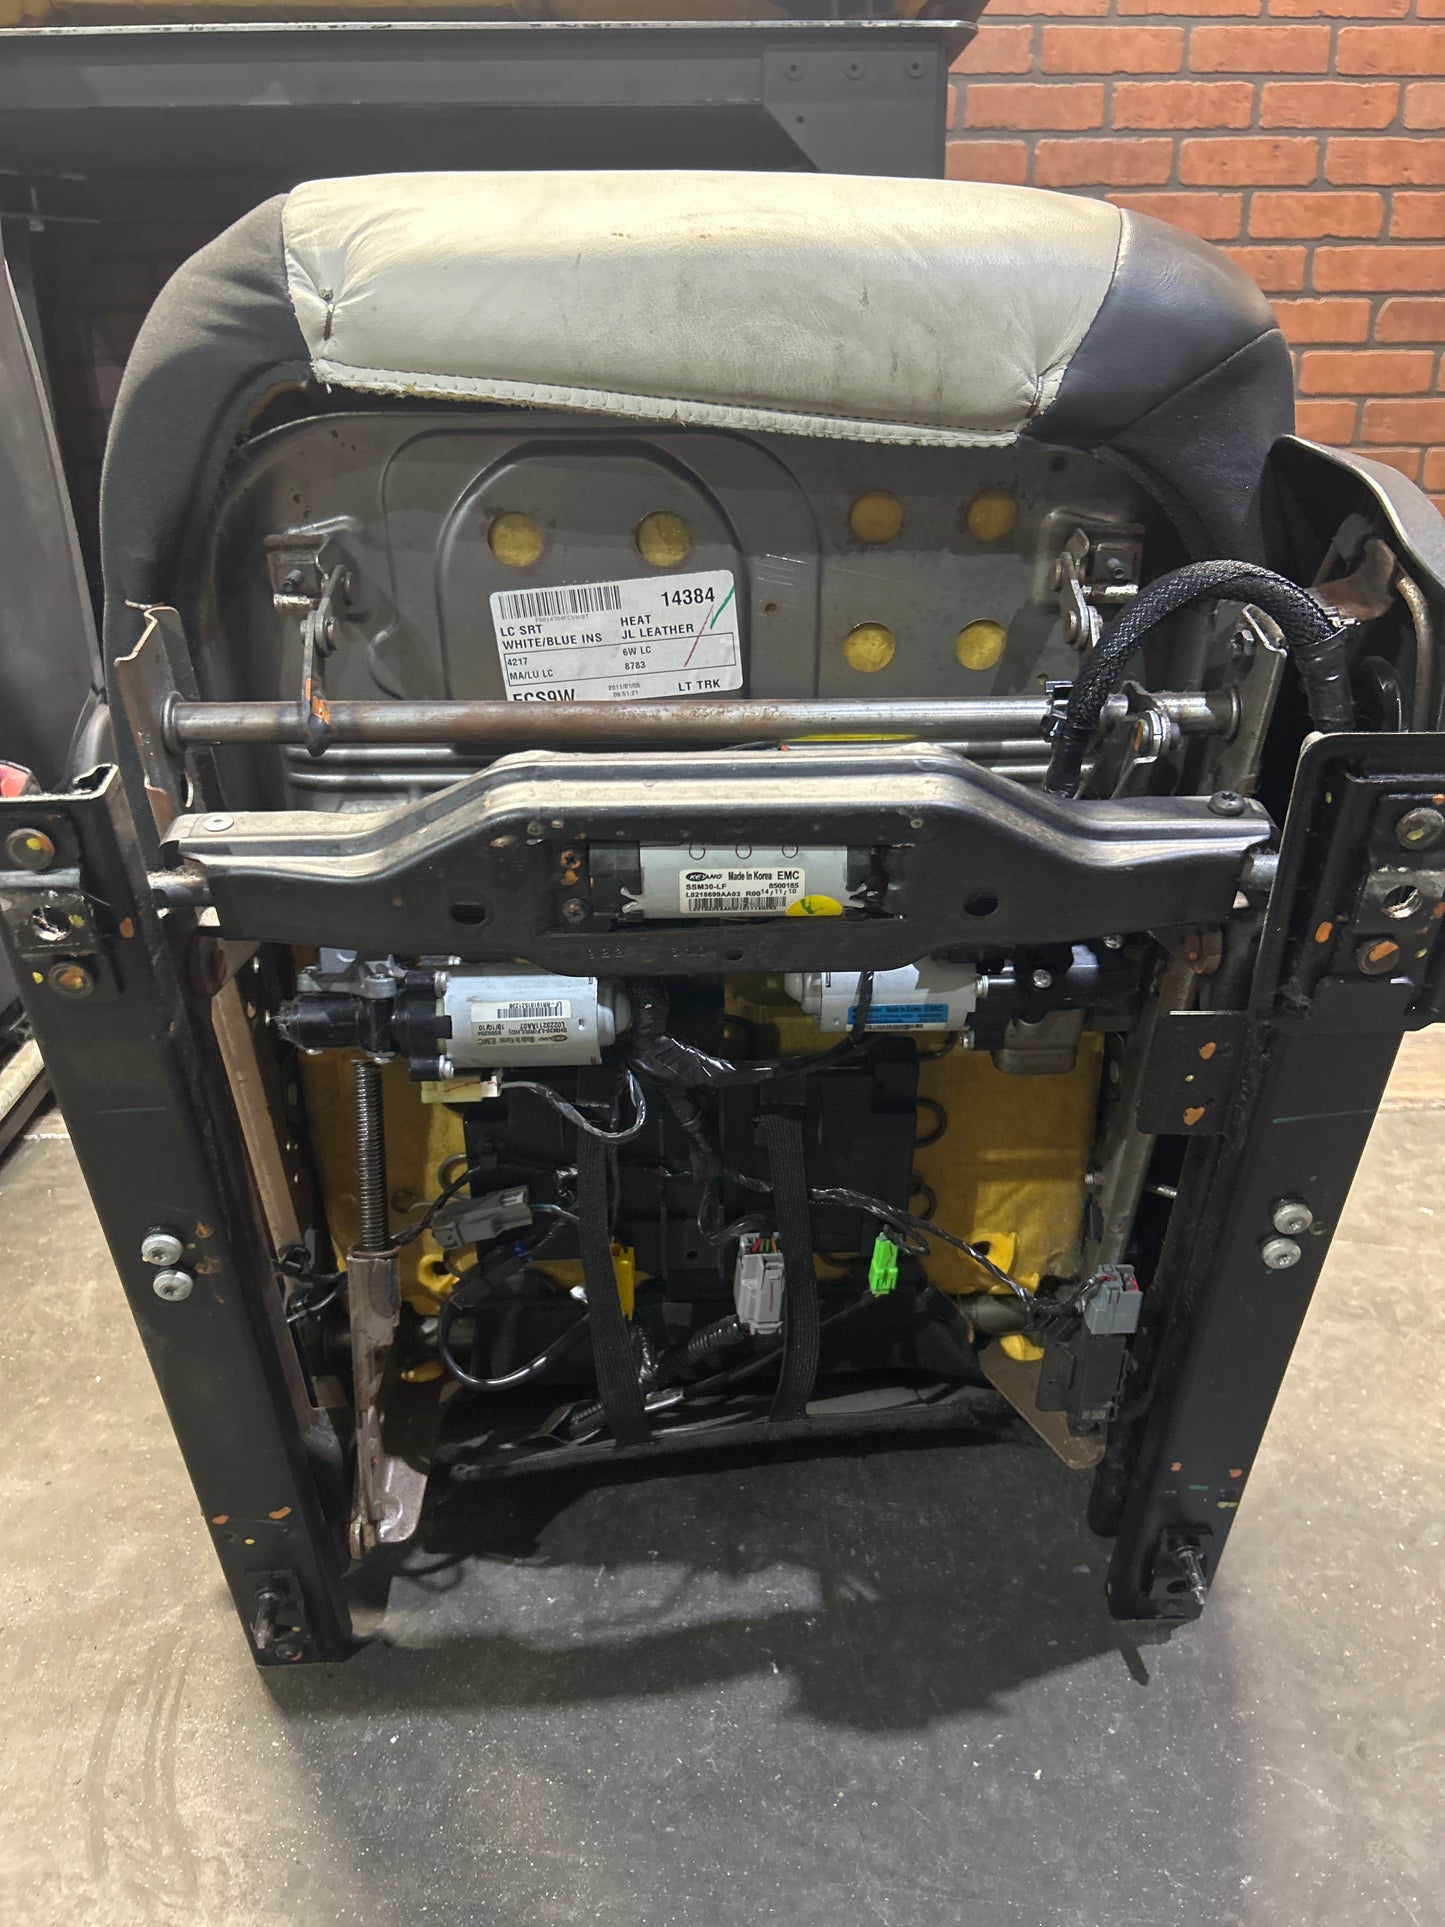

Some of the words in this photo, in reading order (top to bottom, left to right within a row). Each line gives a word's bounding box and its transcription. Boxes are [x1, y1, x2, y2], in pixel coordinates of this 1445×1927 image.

[660, 586, 716, 607] 14384
[620, 614, 652, 627] HEAT
[500, 627, 516, 637] LC
[519, 624, 543, 635] SRT
[621, 629, 636, 640] JL
[639, 623, 695, 638] LEATHER
[502, 634, 578, 650] WHITE/BLUE
[581, 632, 603, 644] INS
[622, 646, 637, 656] 6W
[640, 645, 652, 655] LC
[507, 657, 528, 667] 4217
[624, 660, 646, 671] 8783
[509, 670, 540, 681] MA/LU
[542, 668, 554, 679] LC
[678, 681, 692, 692] LT
[696, 678, 721, 690] TRK
[728, 871, 745, 881] Made
[753, 871, 773, 881] Korea
[777, 870, 800, 880] EMC
[685, 883, 727, 891] SSM30-LF
[476, 1037, 497, 1045] EMC
